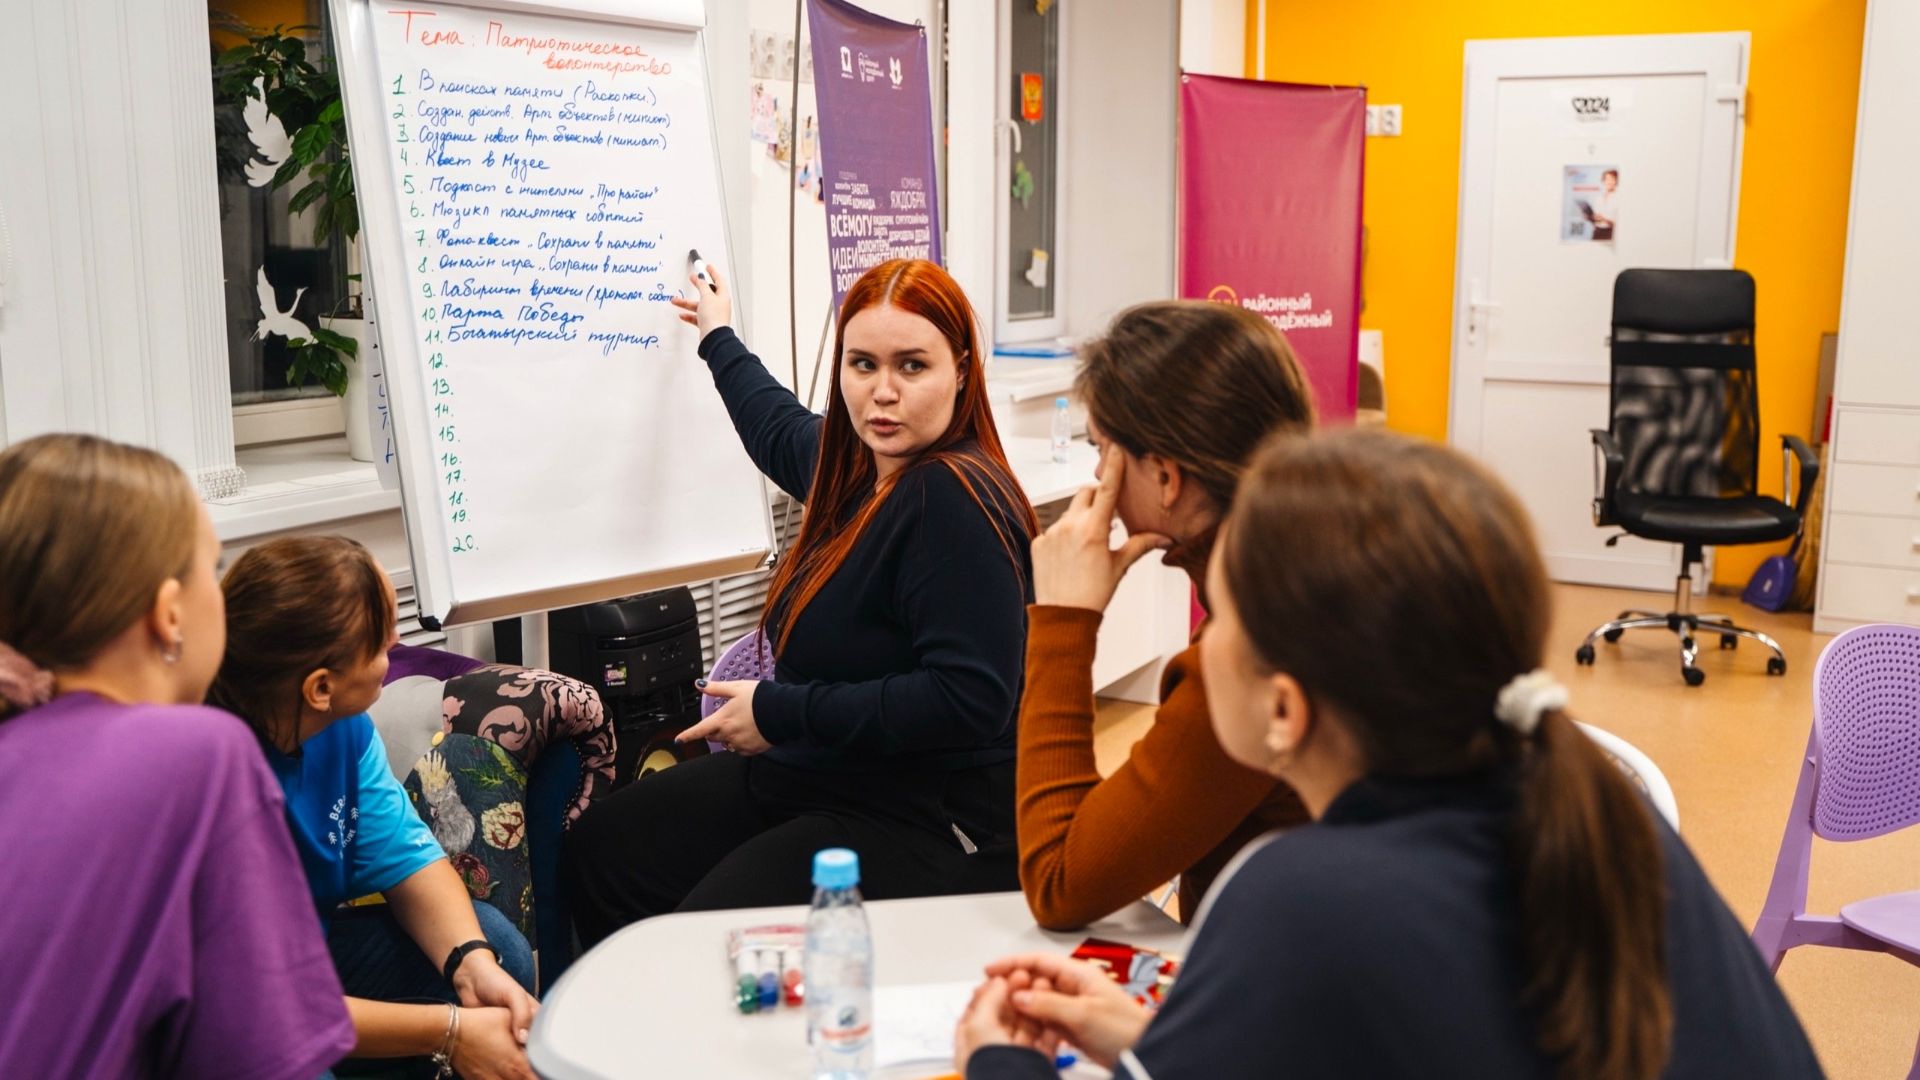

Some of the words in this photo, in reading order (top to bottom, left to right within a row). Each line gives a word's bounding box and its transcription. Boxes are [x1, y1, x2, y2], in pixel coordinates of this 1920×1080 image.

[486, 21, 648, 57] Патриотическое
[418, 67, 435, 91] В
[440, 81, 497, 95] поисках
[504, 85, 563, 99] памяти
[426, 148, 471, 167] Квест
[482, 150, 495, 168] в
[502, 152, 551, 183] Музее
[505, 185, 513, 194] с
[432, 200, 489, 229] Мюзикл
[500, 206, 577, 221] памятных
[830, 208, 872, 238] ВСЁМОГУ
[595, 230, 604, 249] в
[440, 254, 496, 269] Онлайн
[501, 258, 535, 276] игра
[603, 255, 610, 273] в
[832, 247, 858, 273] ИДЕИ
[441, 278, 520, 300] Лабиринт
[530, 278, 583, 301] времени
[422, 307, 438, 323] 10.
[441, 303, 504, 327] Парта
[518, 302, 584, 333] Победы
[425, 329, 443, 344] 11.
[448, 325, 577, 346] Богатырский
[429, 353, 448, 369] 12.
[432, 378, 454, 396] 13.
[434, 403, 454, 418] 14.
[438, 425, 461, 442] 15.
[441, 453, 462, 466] 16.
[445, 469, 466, 485] 17.
[449, 491, 468, 506] 18.
[452, 509, 471, 523] 19.
[453, 534, 479, 552] 20.
